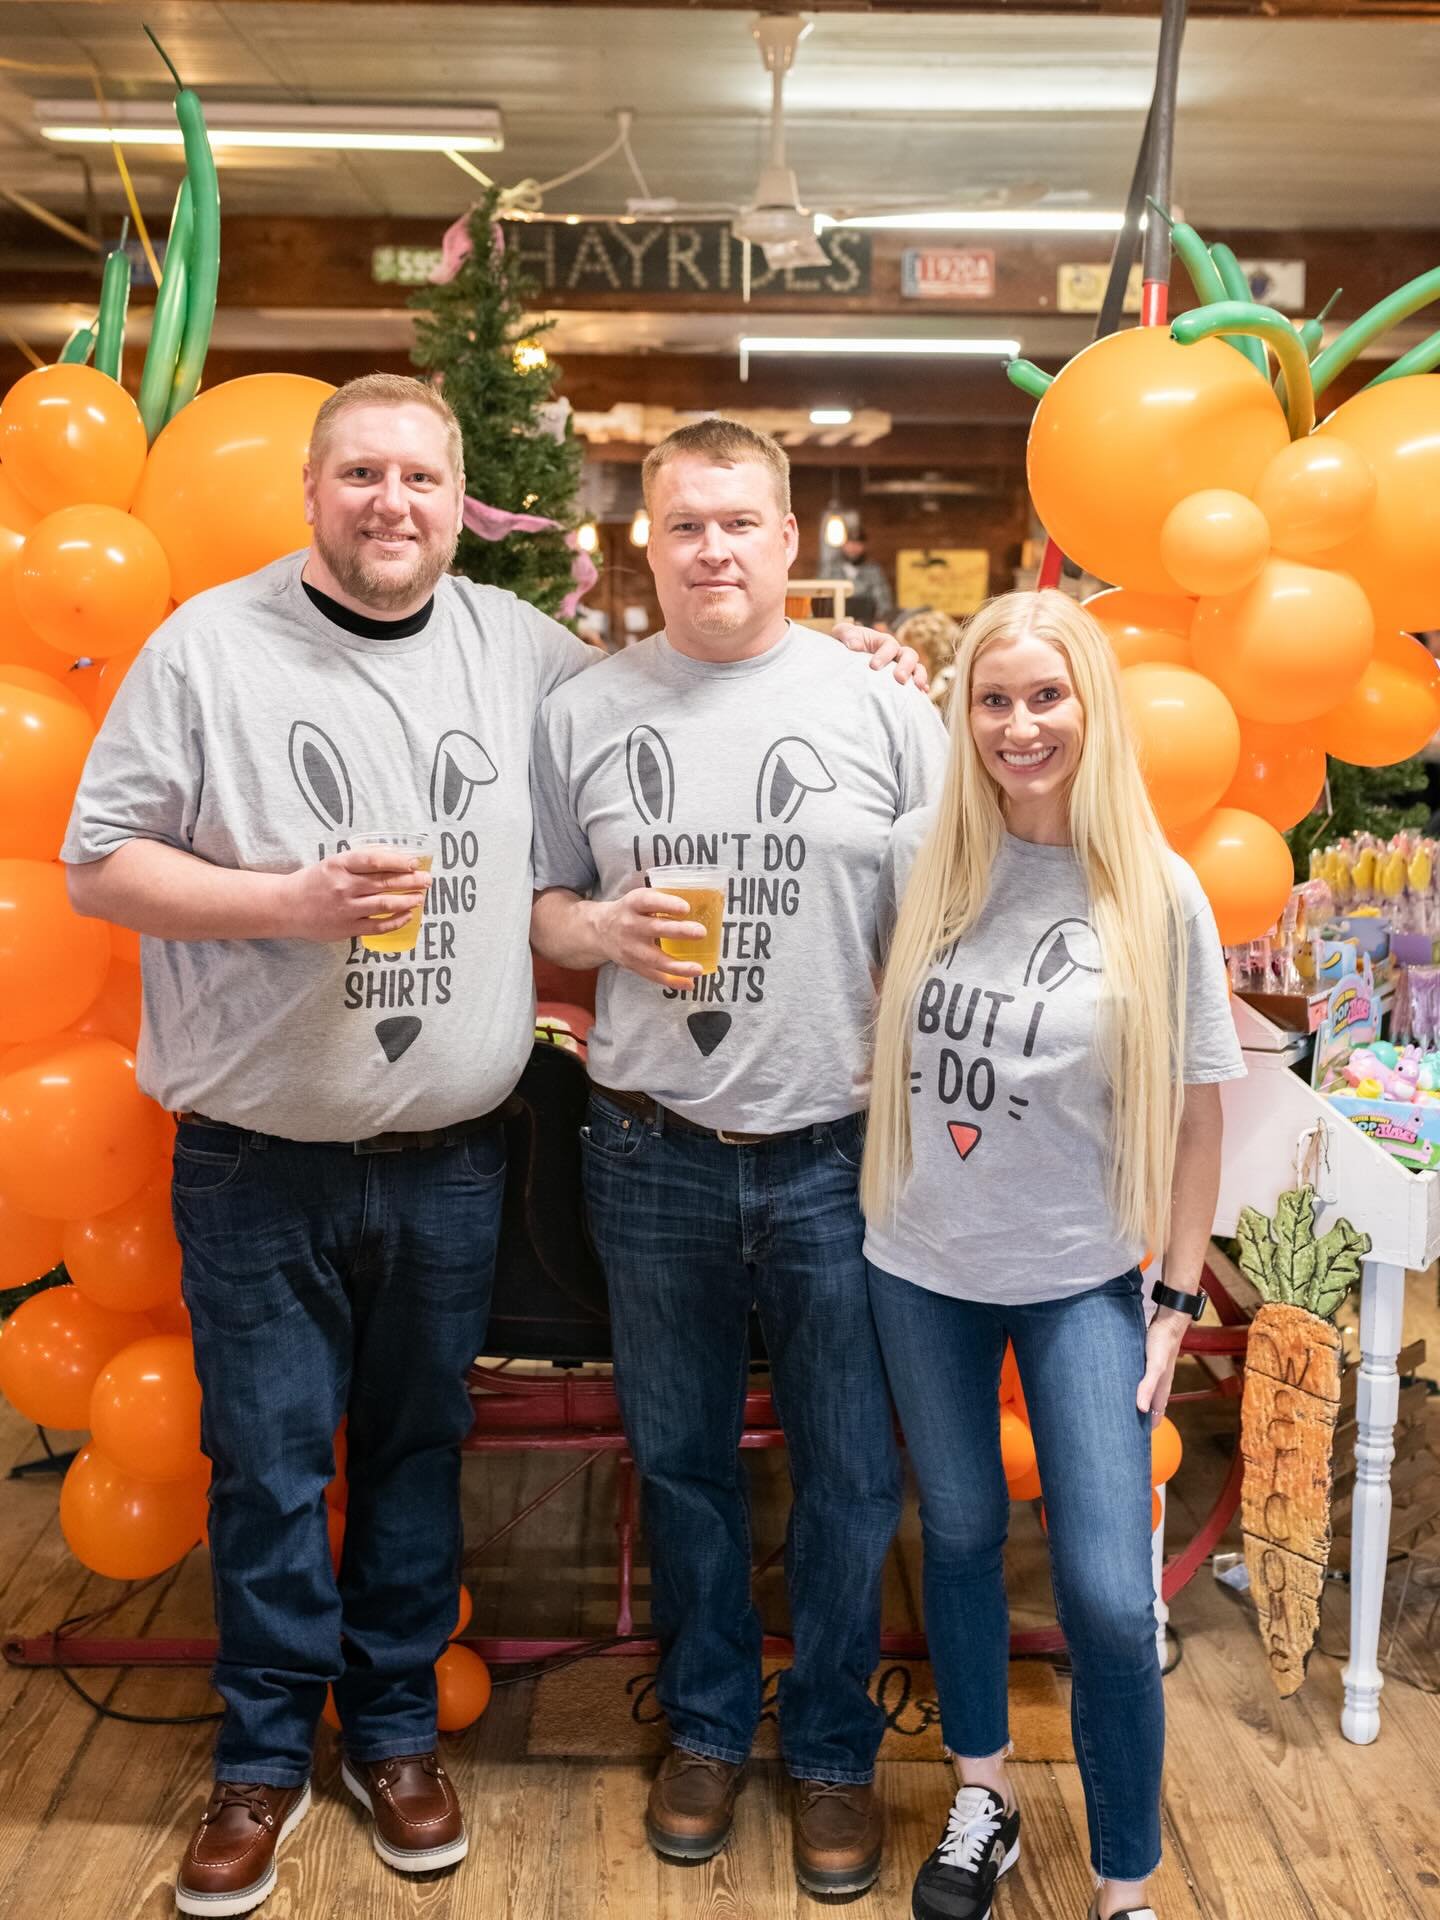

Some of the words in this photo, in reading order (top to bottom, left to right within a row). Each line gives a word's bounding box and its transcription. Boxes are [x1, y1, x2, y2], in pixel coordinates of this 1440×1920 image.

[510, 223, 861, 292] HAYRIS
[440, 831, 479, 870] DO
[633, 835, 642, 872] I
[653, 832, 751, 871] DON'T
[764, 834, 806, 872] DO
[344, 966, 452, 1009] SHIRTS
[918, 977, 1015, 1048] BUT
[1022, 1001, 1045, 1057] I
[938, 1048, 995, 1112] DO
